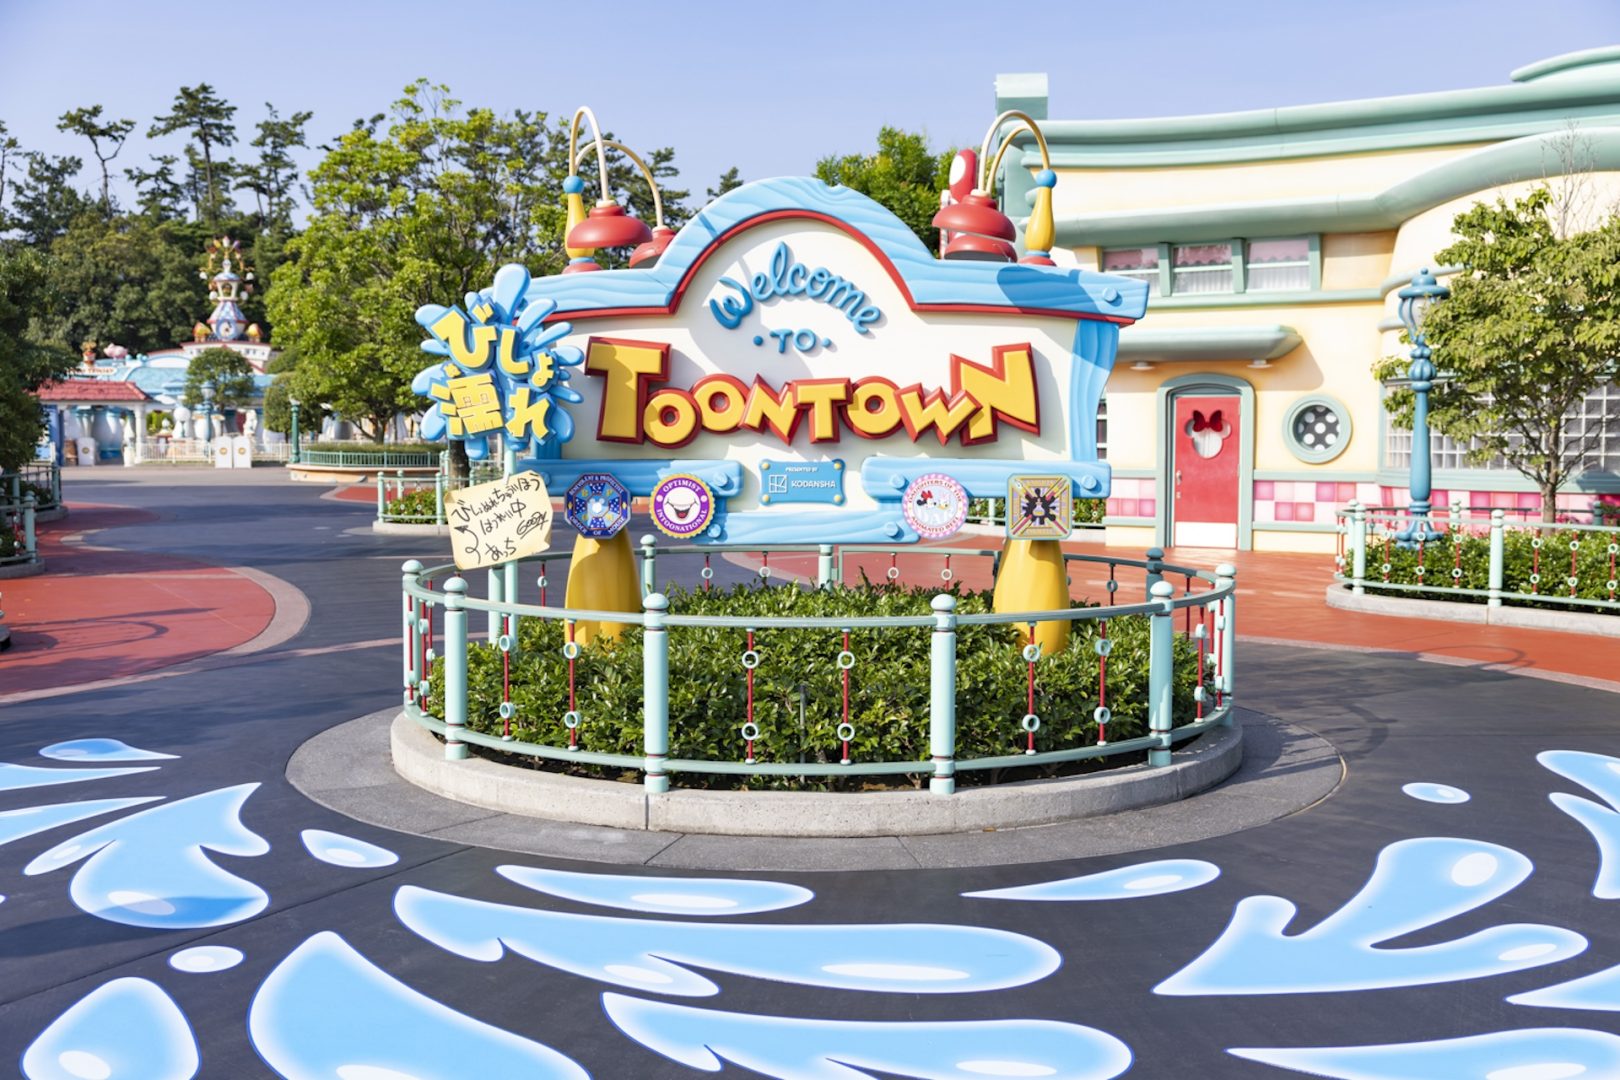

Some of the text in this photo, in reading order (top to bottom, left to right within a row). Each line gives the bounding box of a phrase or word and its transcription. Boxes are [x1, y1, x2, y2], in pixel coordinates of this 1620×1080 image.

[709, 241, 880, 334] Welcome
[431, 303, 554, 388] びしょ
[662, 479, 702, 493] OPTIMIST
[791, 480, 836, 489] KODANSHA
[569, 516, 588, 534] ORDER
[656, 509, 708, 532] INTOONATIONAL
[485, 537, 517, 561] あっち
